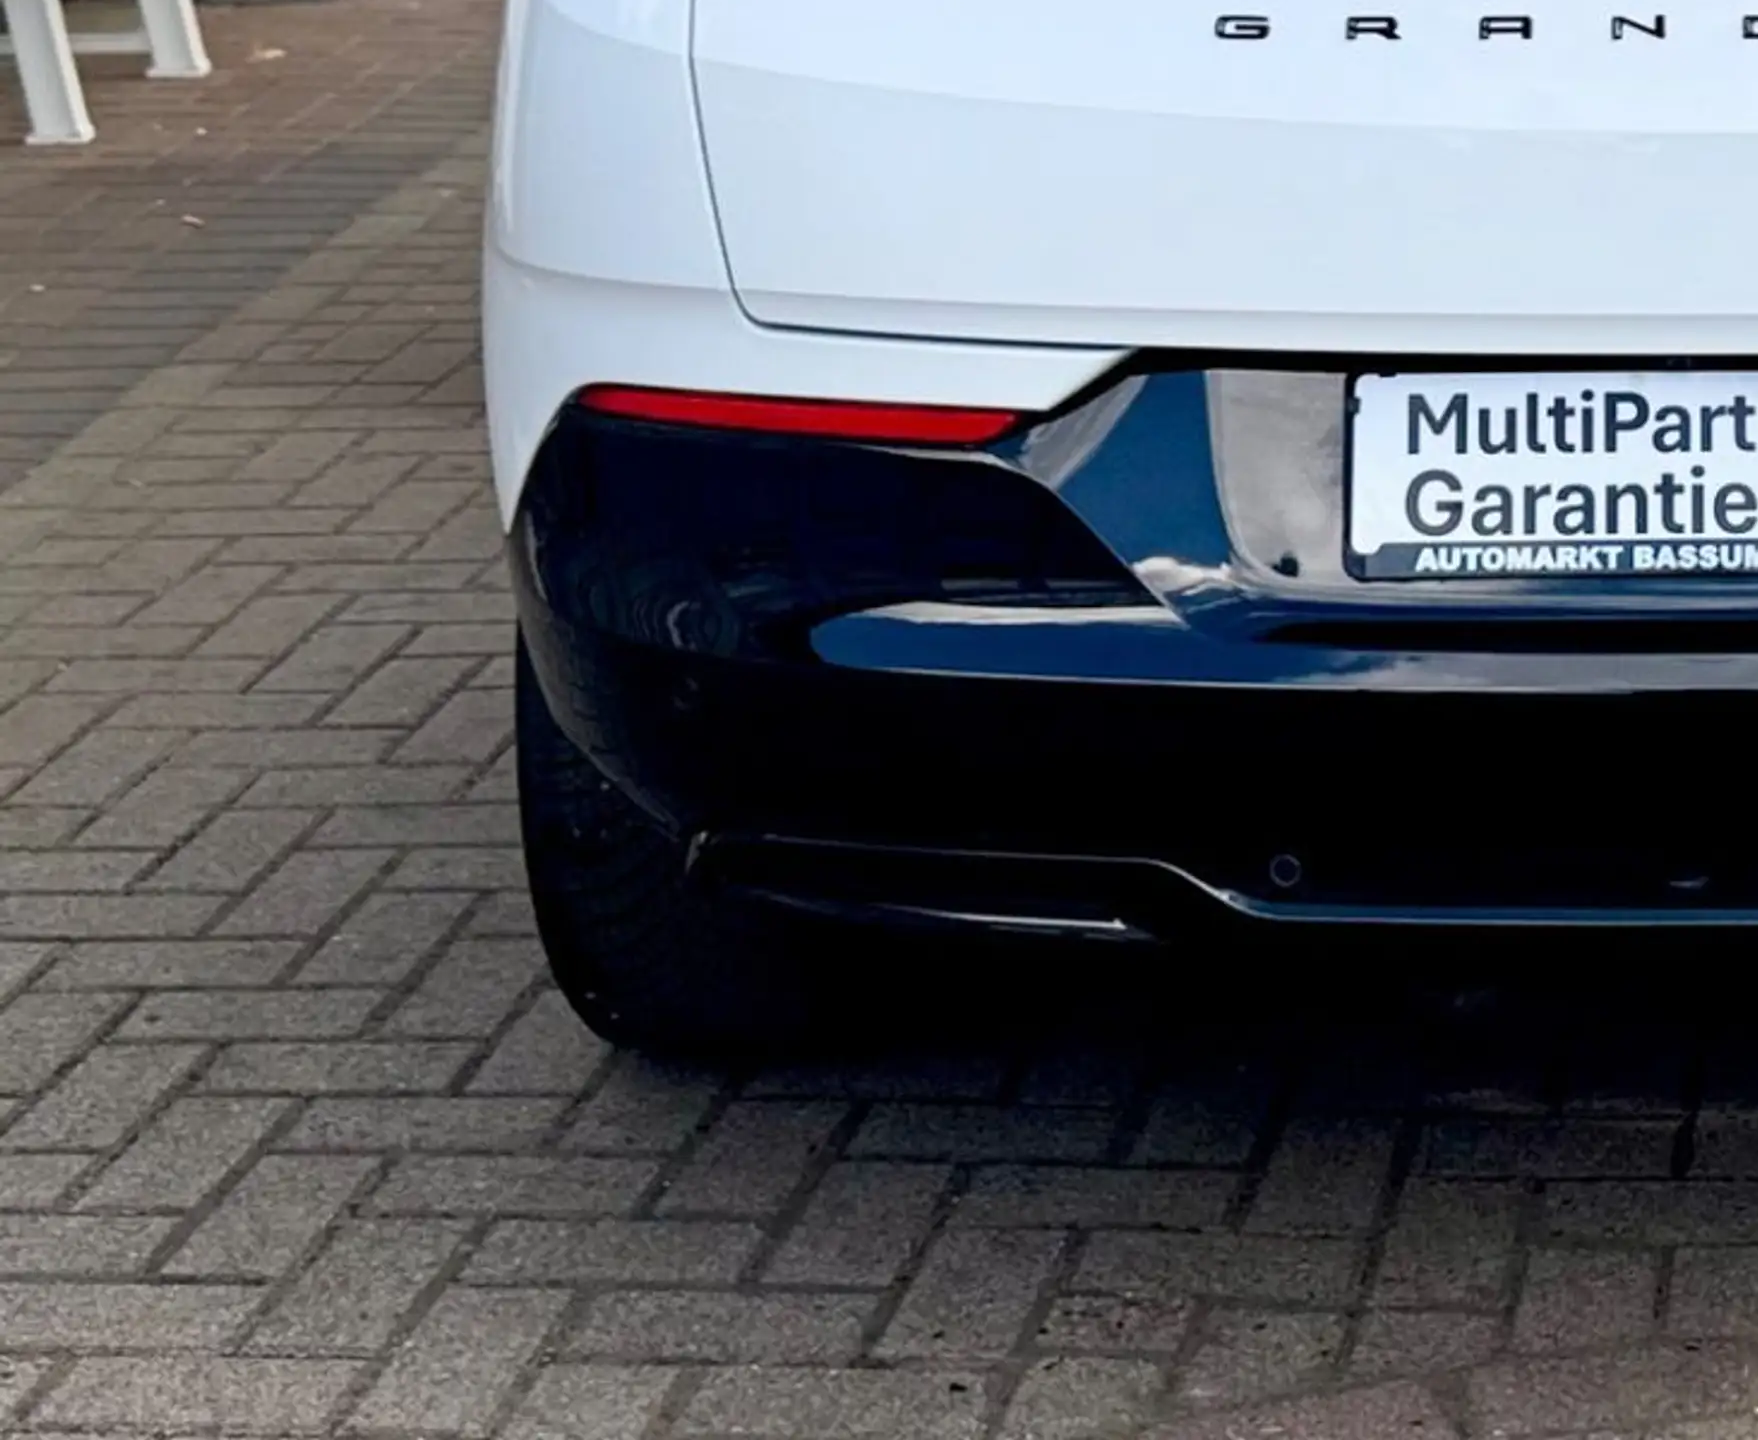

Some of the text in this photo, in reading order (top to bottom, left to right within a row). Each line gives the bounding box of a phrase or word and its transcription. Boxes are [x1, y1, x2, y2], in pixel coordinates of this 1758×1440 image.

[1407, 389, 1757, 455] MultiPart
[1405, 465, 1758, 537] Garantie
[1415, 545, 1625, 572] AUTOMARKT
